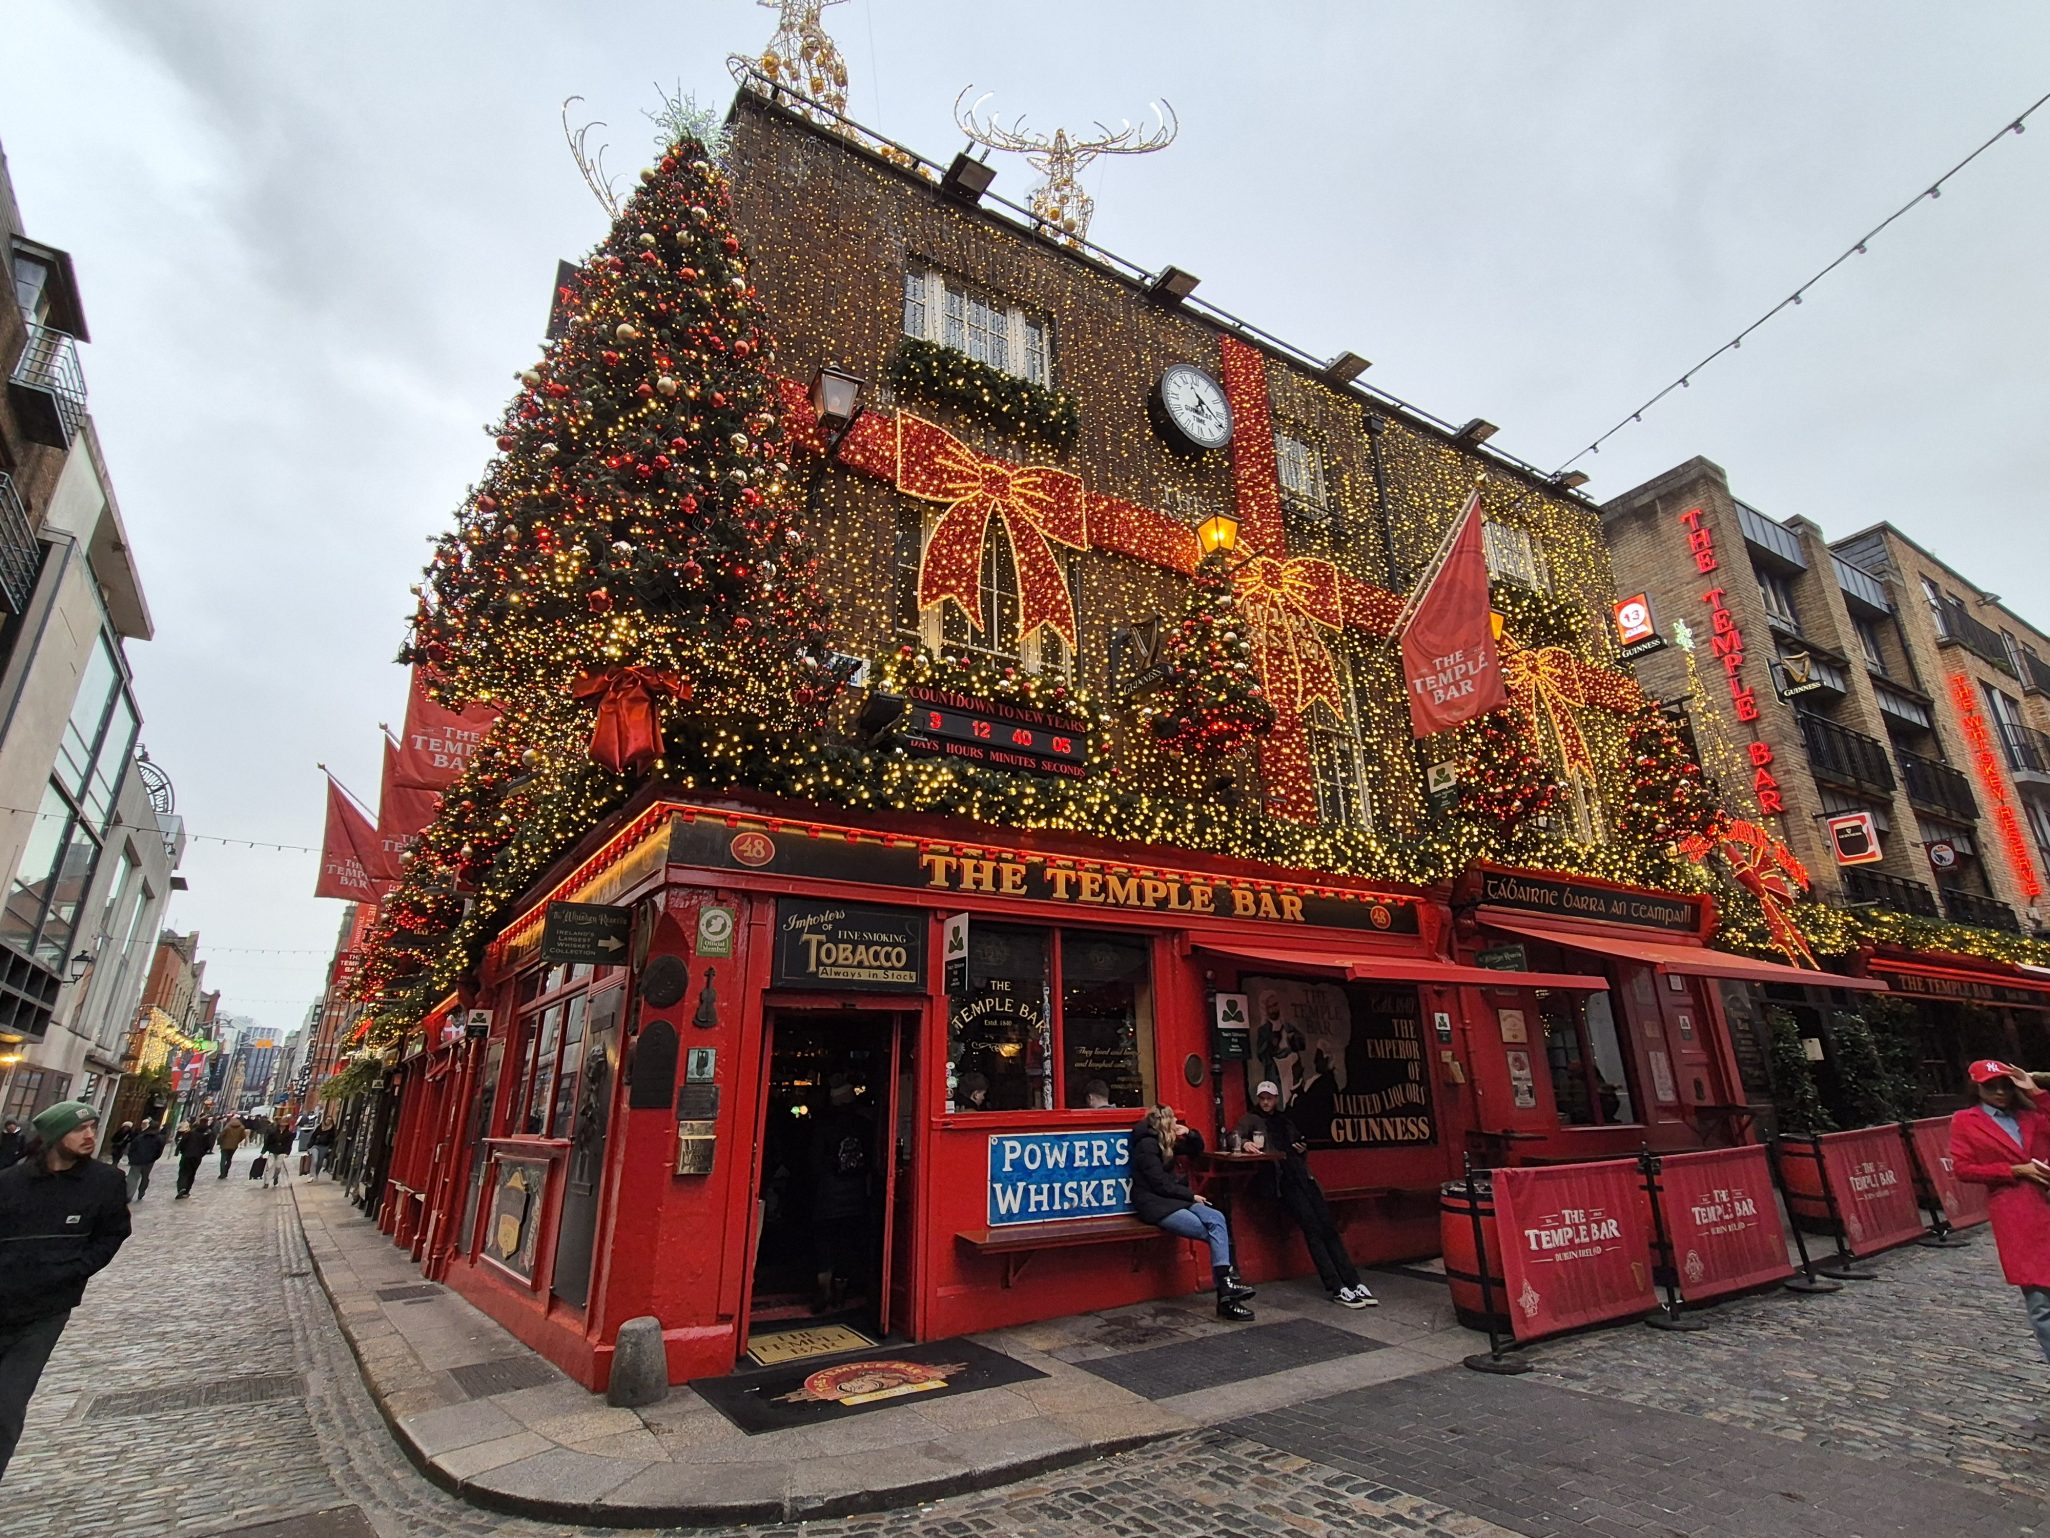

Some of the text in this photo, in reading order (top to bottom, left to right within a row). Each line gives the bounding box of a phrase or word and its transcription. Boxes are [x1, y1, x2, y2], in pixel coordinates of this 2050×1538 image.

[1623, 609, 1640, 623] 13
[1622, 639, 1661, 658] GUINNESS
[1432, 650, 1465, 671] THE
[1680, 508, 1784, 815] THE TEMPLE BAR
[1412, 651, 1488, 694] TEMPLE
[1433, 679, 1475, 705] BAR
[1783, 682, 1821, 697] GUINNESS
[908, 685, 1085, 733] COUNTDOWN TO NEW YEARS
[443, 726, 480, 743] THE
[928, 711, 1072, 754] 3 12 40 05
[1953, 676, 1974, 711] THE
[1965, 715, 2004, 800] WHISKEY
[411, 734, 477, 757] TEMP
[433, 753, 466, 771] BA
[910, 739, 1086, 778] DAYS HOURS MINUTES SECONDS
[738, 836, 765, 858] 48
[340, 876, 368, 888] BAR
[922, 853, 1305, 922] THE TEMPLE BAR
[783, 909, 846, 934] Importers
[822, 922, 834, 932] OF
[1373, 909, 1386, 924] 48
[838, 929, 906, 944] FINE SMOKING
[549, 947, 596, 956] COLLECTION
[799, 933, 907, 974] TOBACCO
[820, 966, 914, 982] Always in Stock
[990, 980, 1011, 991] THE
[1899, 974, 1926, 992] THE
[1926, 978, 1972, 998] TEMPLE
[951, 997, 1047, 1034] TEMPLE BAR
[1291, 1003, 1346, 1021] TEMPLE
[1306, 1020, 1335, 1036] BAR
[1392, 1018, 1417, 1039] THE
[1366, 1038, 1421, 1059] EMPEROR
[1407, 1060, 1421, 1081] OF
[1333, 1092, 1382, 1116] MALTED
[1331, 1116, 1430, 1143] GUINNESS
[1002, 1138, 1130, 1171] POWER'S
[1862, 1162, 1874, 1174] THE
[1879, 1169, 1897, 1186] BAR
[993, 1178, 1133, 1215] WHISKEY
[1713, 1188, 1729, 1203] THE
[1562, 1208, 1585, 1225] THE
[1735, 1198, 1757, 1217] BAR
[1524, 1218, 1621, 1251] TEMPLE BAR
